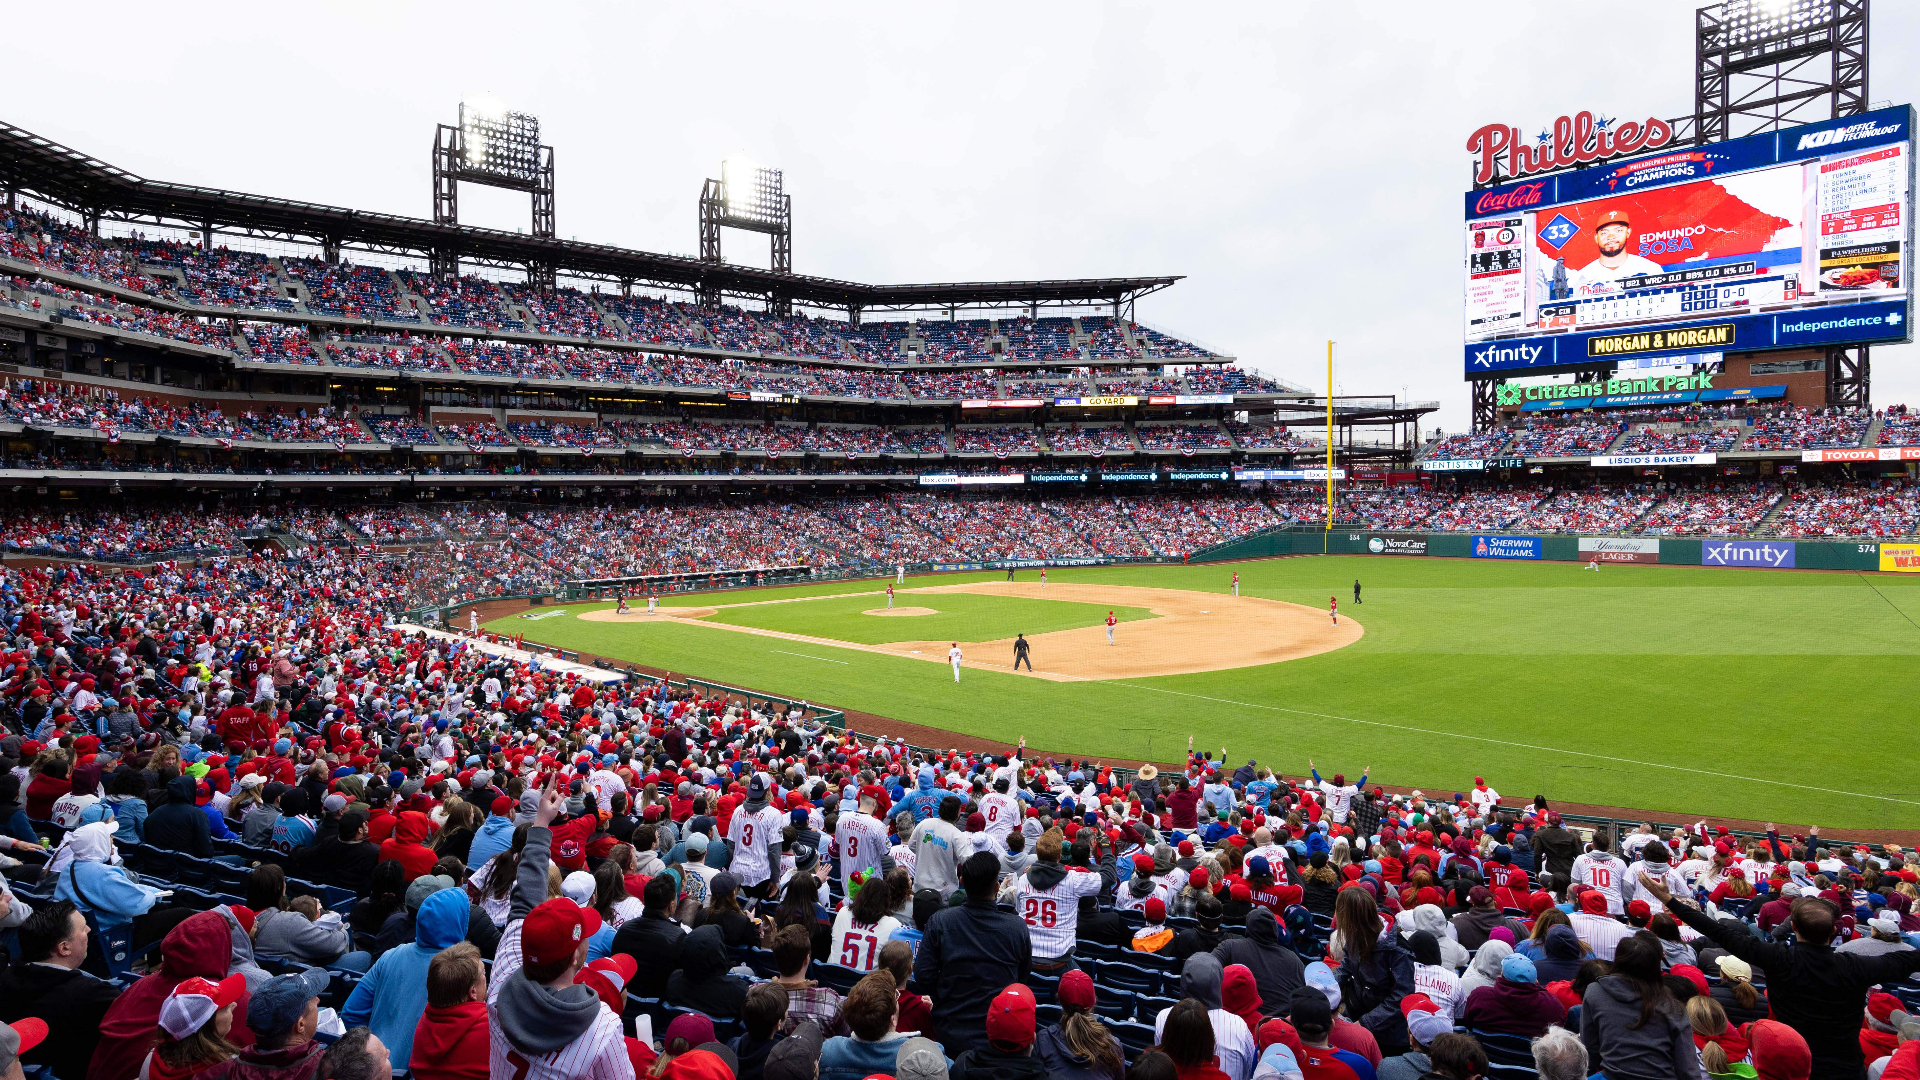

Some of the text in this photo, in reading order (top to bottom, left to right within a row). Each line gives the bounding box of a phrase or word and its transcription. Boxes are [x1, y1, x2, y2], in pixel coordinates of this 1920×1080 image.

[1844, 124, 1901, 141] TECHNOLOGY
[1846, 121, 1877, 134] OFFICE
[1797, 127, 1847, 151] KDI
[1466, 110, 1672, 184] Phillies
[1630, 154, 1690, 170] PHILADELPHIA PHILLIES
[1634, 162, 1687, 176] NATIONAL LEAGUE
[1625, 166, 1695, 187] CHAMPIONS
[1476, 181, 1546, 214] Coca-Cola
[1548, 223, 1571, 240] 33
[1639, 225, 1706, 244] EDMUNDO
[1638, 237, 1694, 257] SOSA
[1706, 269, 1720, 277] 0.0
[1739, 265, 1753, 273] 0.0
[1724, 288, 1745, 298] 0-0
[1782, 316, 1882, 333] Independence
[1595, 328, 1726, 354] MORGAN & MORGAN
[1474, 344, 1543, 368] xfinity
[1525, 371, 1714, 400] Citizens Bank Park
[1609, 455, 1696, 464] LISCIO'S BAKERY
[1825, 451, 1876, 460] TOYOTA
[1424, 459, 1522, 470] DENTISTRY for LIFE
[1030, 474, 1079, 482] Independence
[1101, 473, 1149, 481] Independence
[1170, 472, 1220, 480] Independence
[1490, 538, 1533, 547] SHERWIN
[1858, 545, 1876, 553] 374
[1489, 547, 1534, 557] WILLIAMS
[1601, 552, 1634, 560] LAGER
[1707, 541, 1789, 566] xfinity
[1017, 560, 1045, 568] NETWORK
[248, 663, 258, 672] 19
[1256, 791, 1265, 801] 7
[1335, 795, 1341, 806] 7
[1484, 794, 1490, 803] 3
[55, 802, 80, 816] HARPER
[921, 805, 934, 820] 3
[988, 806, 998, 822] 8
[842, 820, 868, 834] HARPER
[742, 824, 753, 846] 3
[847, 836, 858, 857] 3
[1495, 872, 1508, 886] 10
[1590, 867, 1610, 887] 10
[1250, 890, 1278, 905] LMUTO
[1024, 898, 1057, 928] 26
[840, 931, 878, 971] 51
[1414, 973, 1453, 996] ELLANOS
